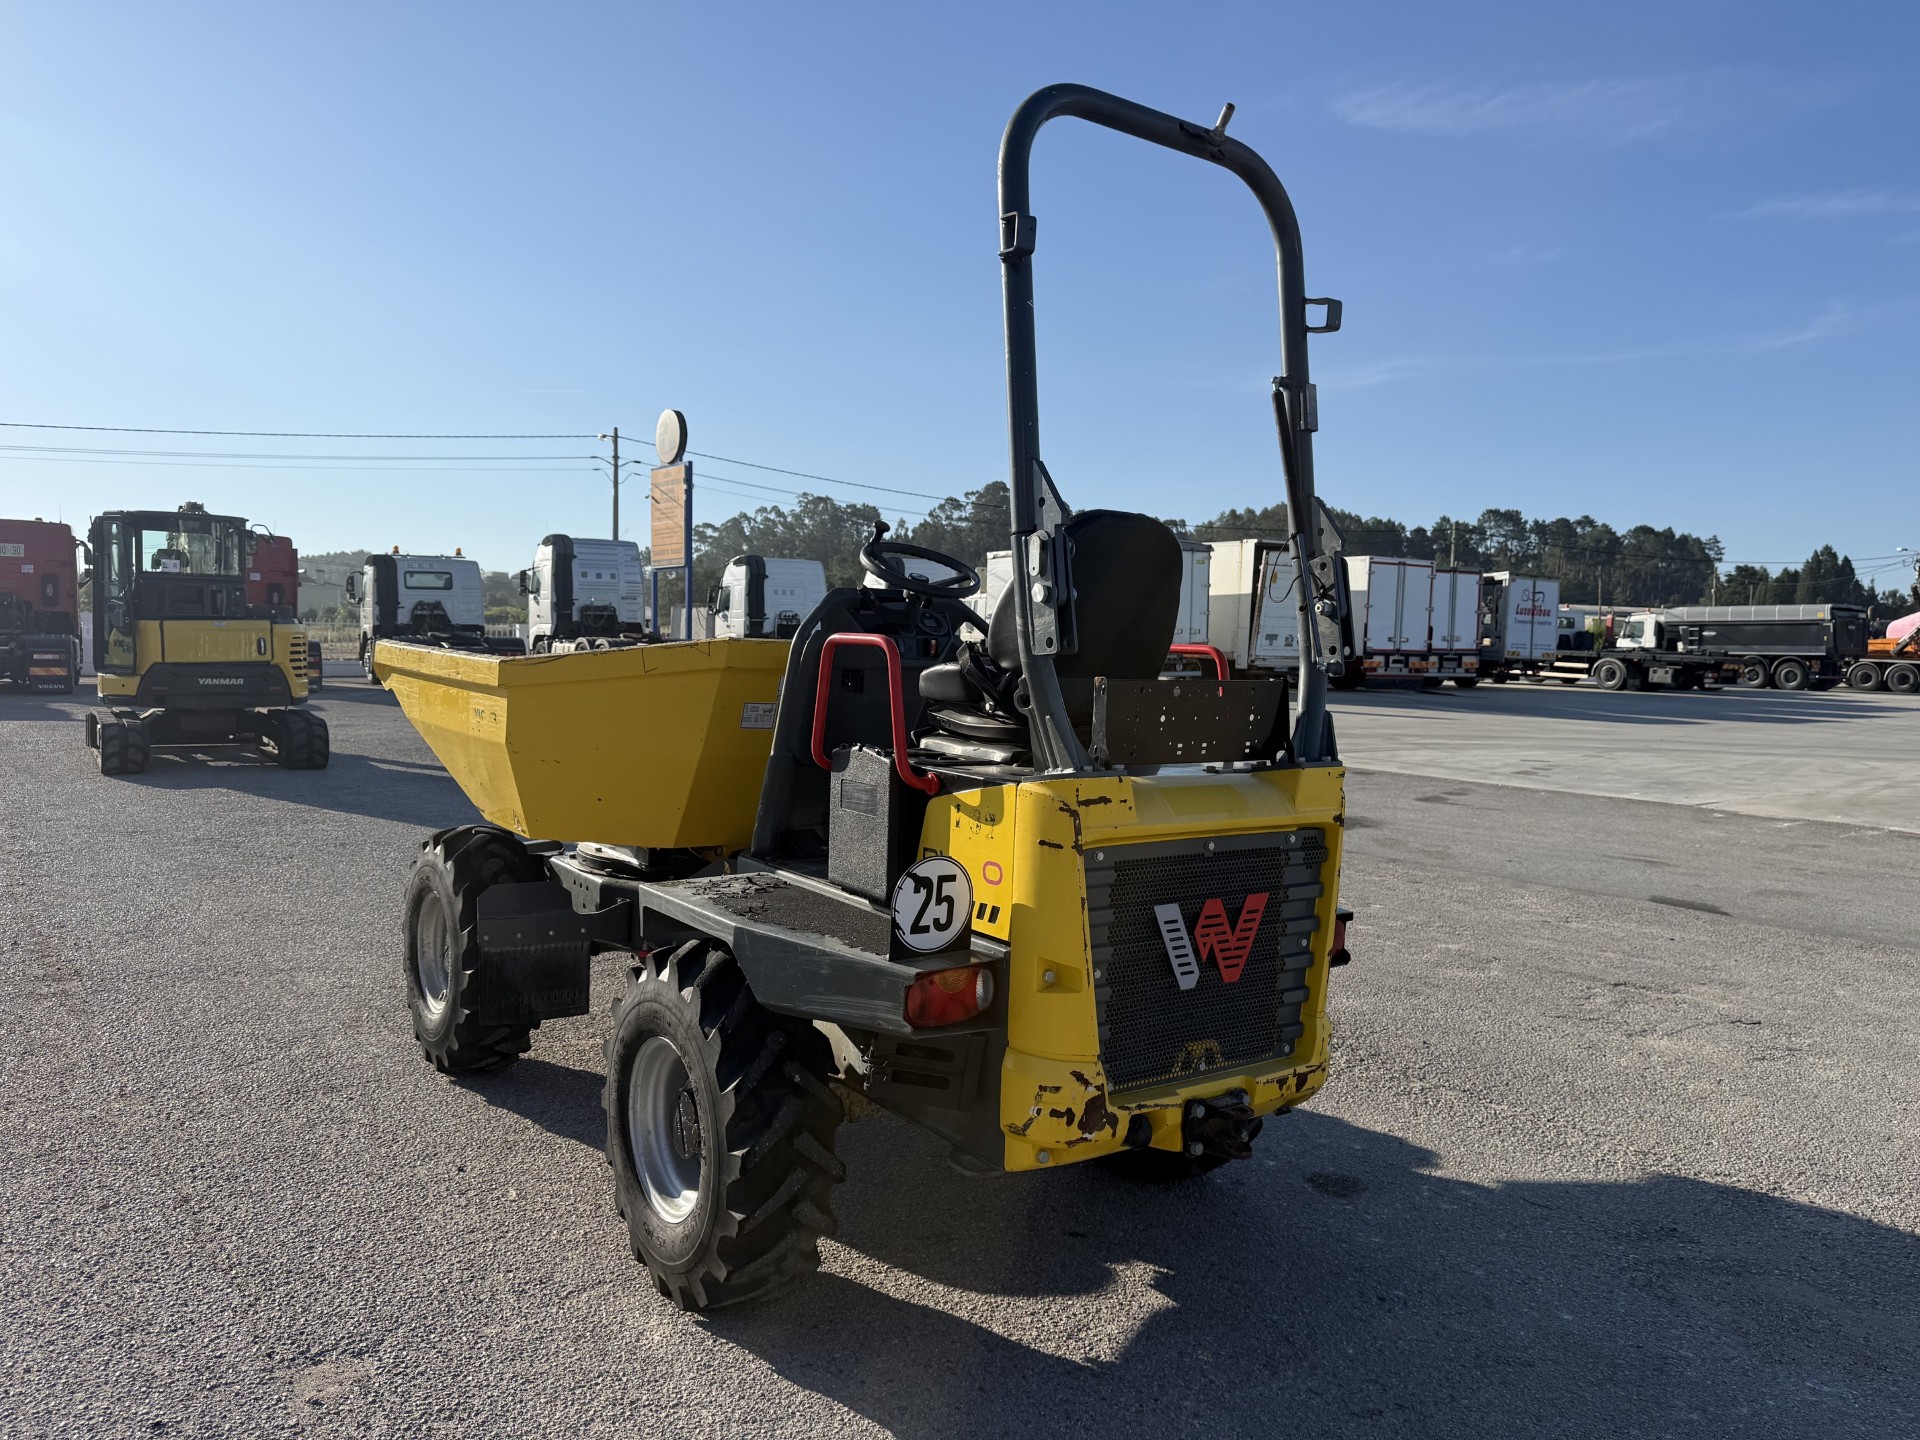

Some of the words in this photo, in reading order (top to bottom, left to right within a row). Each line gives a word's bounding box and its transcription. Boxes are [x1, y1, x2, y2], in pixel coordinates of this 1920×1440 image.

[12, 545, 21, 555] 90
[197, 677, 244, 686] YANMAR
[909, 873, 957, 936] 25
